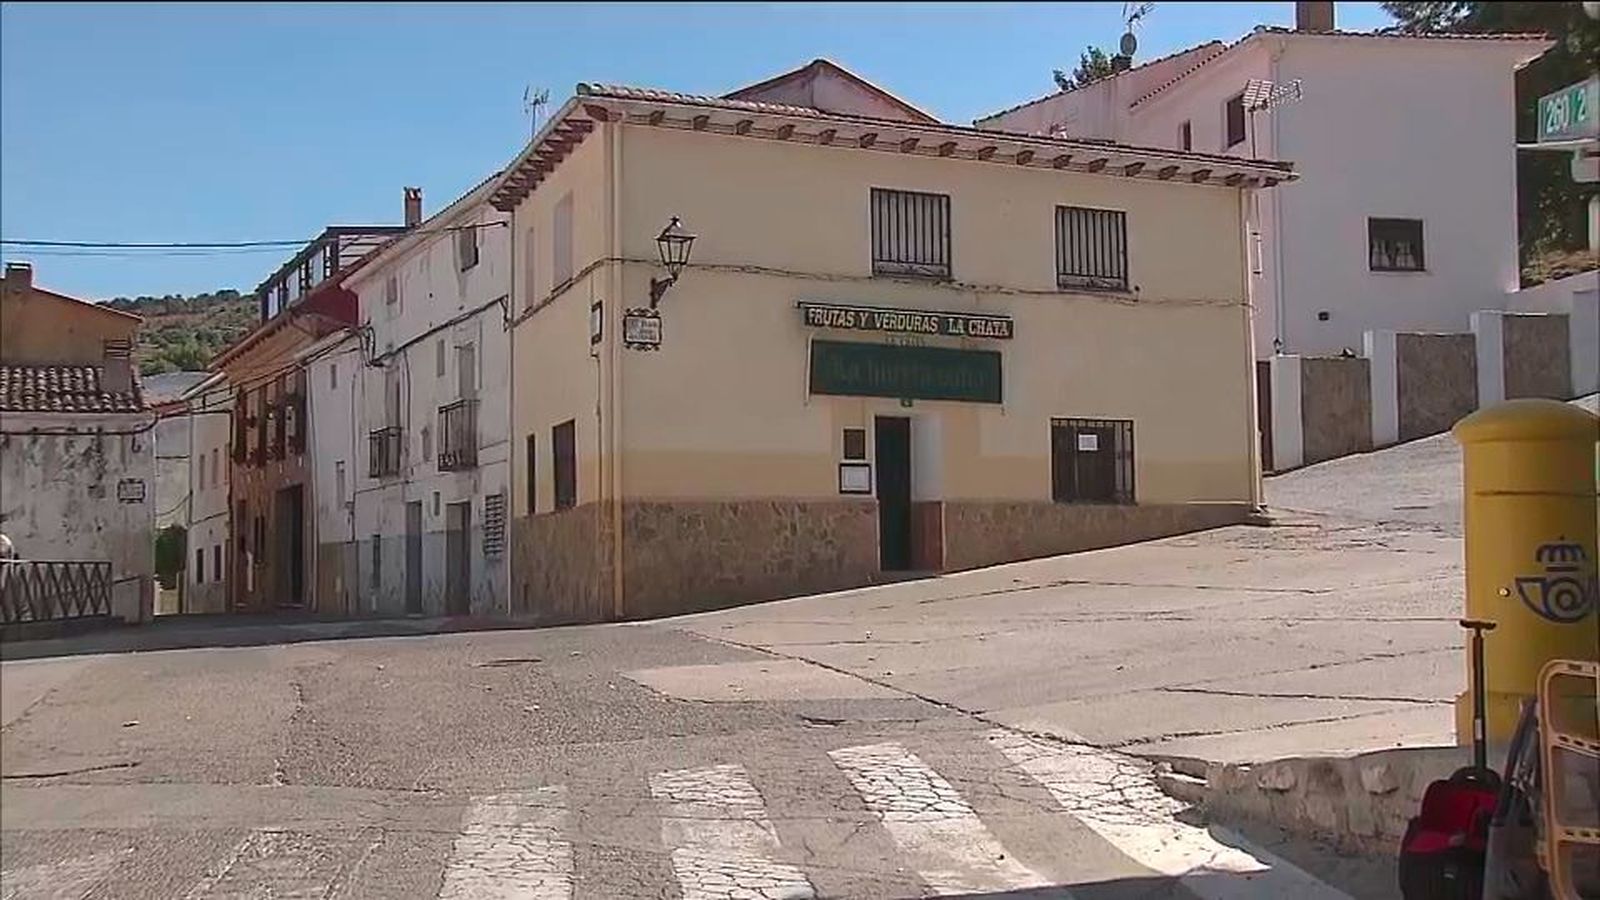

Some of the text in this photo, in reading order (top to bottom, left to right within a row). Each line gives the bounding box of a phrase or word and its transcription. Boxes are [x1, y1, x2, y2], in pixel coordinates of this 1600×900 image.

[808, 307, 1009, 336] FRUTAS Y VERDURAS LA CHATA
